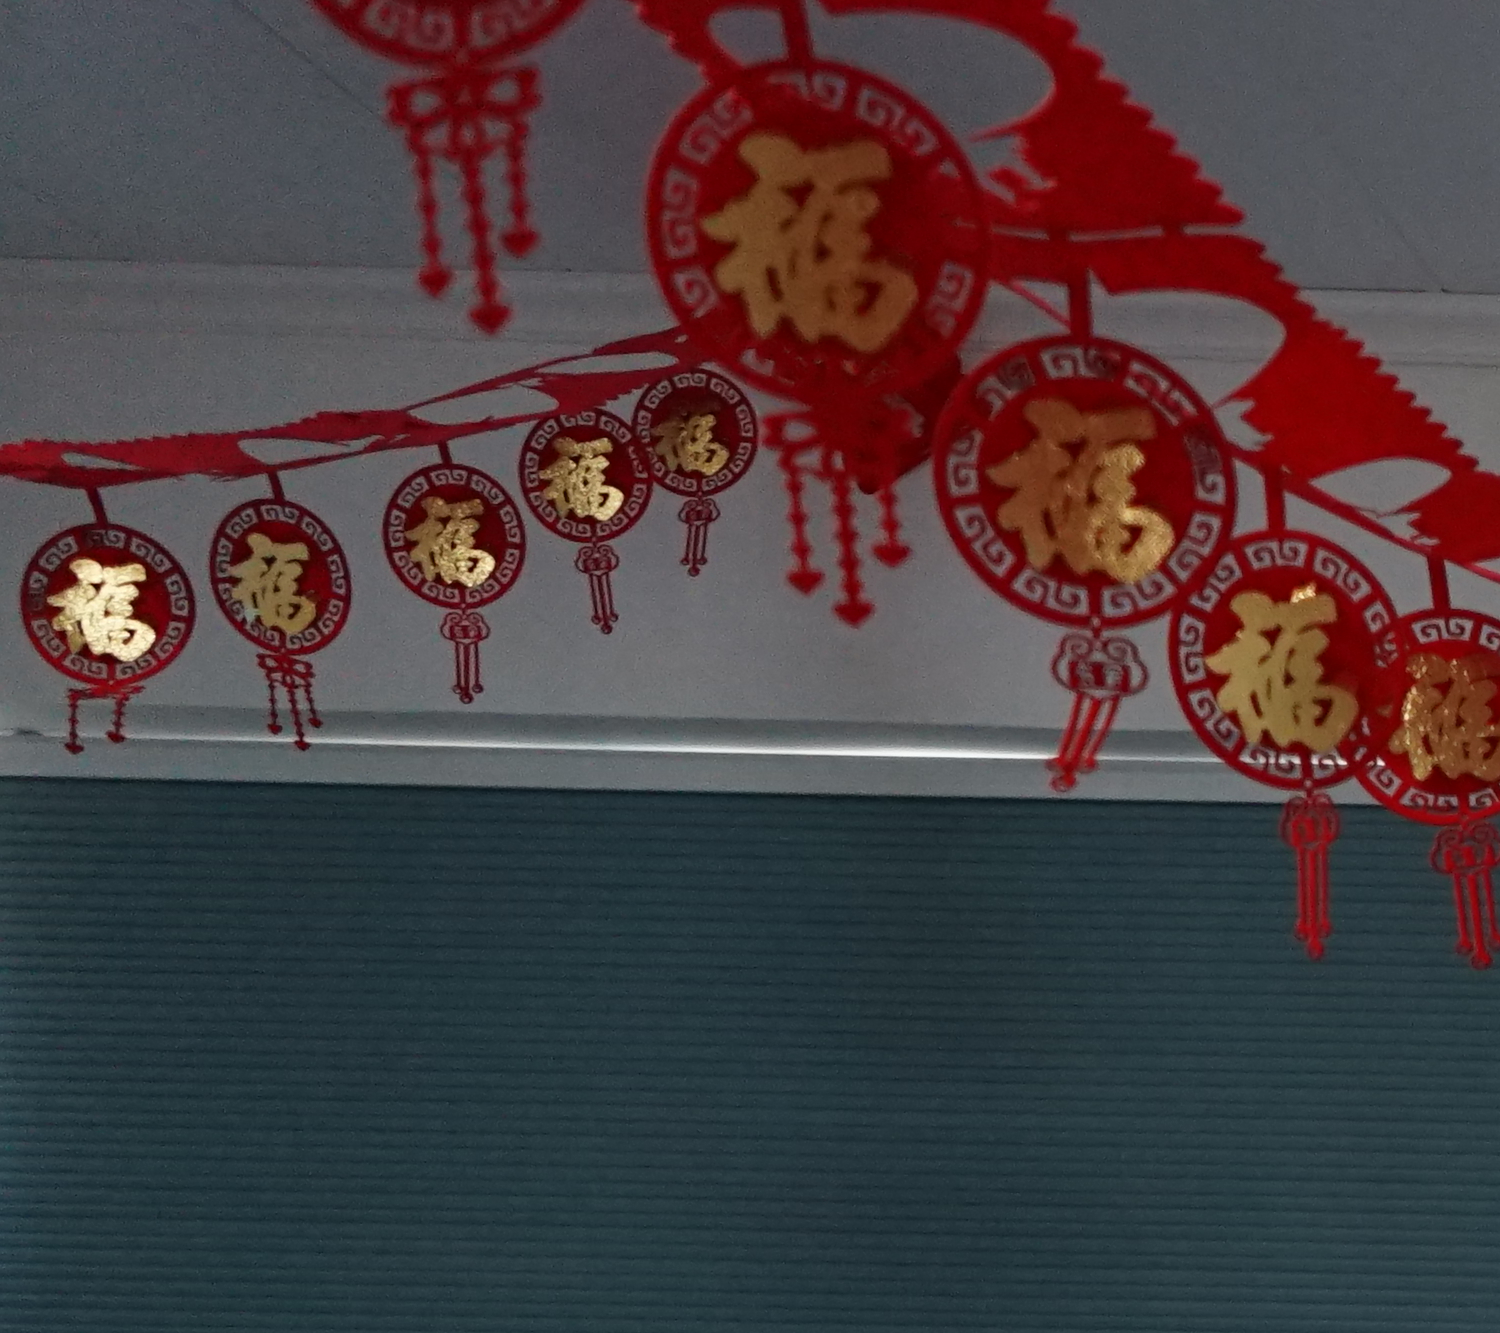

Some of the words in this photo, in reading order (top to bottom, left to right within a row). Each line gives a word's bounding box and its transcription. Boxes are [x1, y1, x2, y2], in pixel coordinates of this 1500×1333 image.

[702, 131, 919, 354] 福
[540, 436, 625, 522] 福
[651, 404, 729, 476] 福
[403, 495, 496, 589] 福
[986, 400, 1175, 585] 福
[47, 558, 158, 663] 福
[230, 531, 318, 634] 福
[1206, 580, 1360, 755] 福
